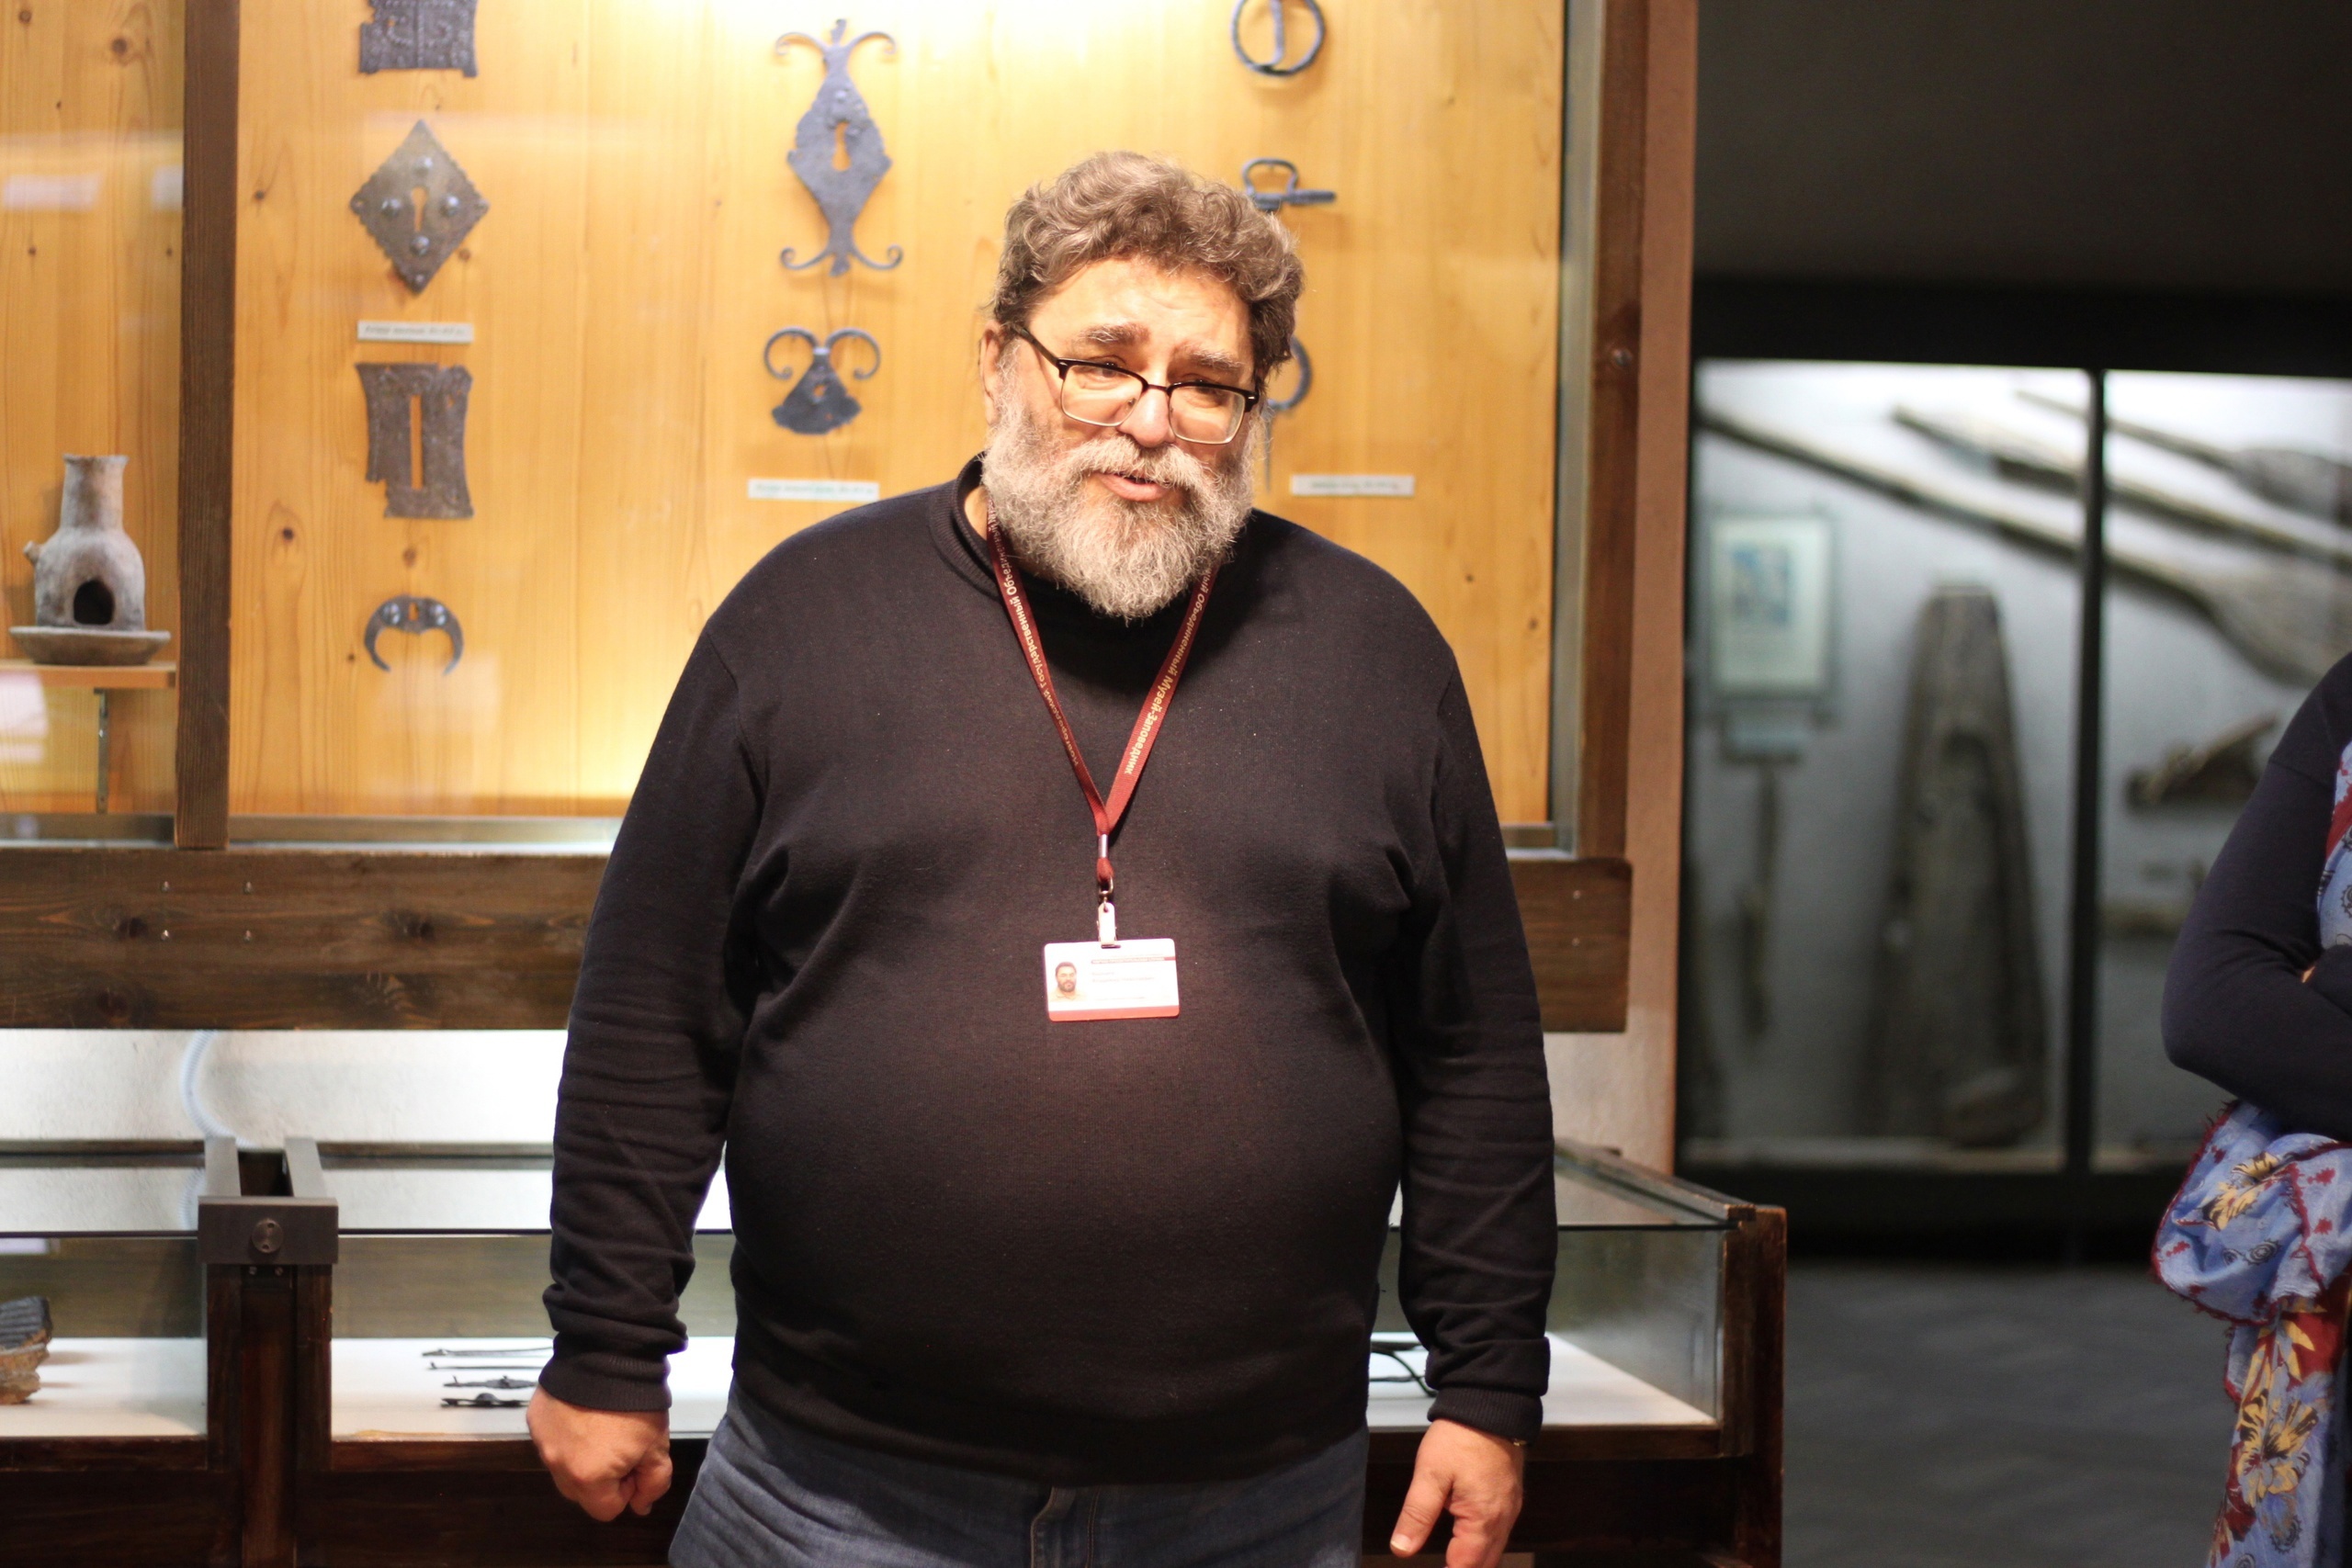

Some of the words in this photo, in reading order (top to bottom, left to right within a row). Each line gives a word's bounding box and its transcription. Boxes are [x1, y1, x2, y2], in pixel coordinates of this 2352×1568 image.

[1010, 595, 1047, 688] Государственный
[1168, 593, 1204, 676] Объединенный
[1125, 675, 1174, 774] Музей-Заповедник
